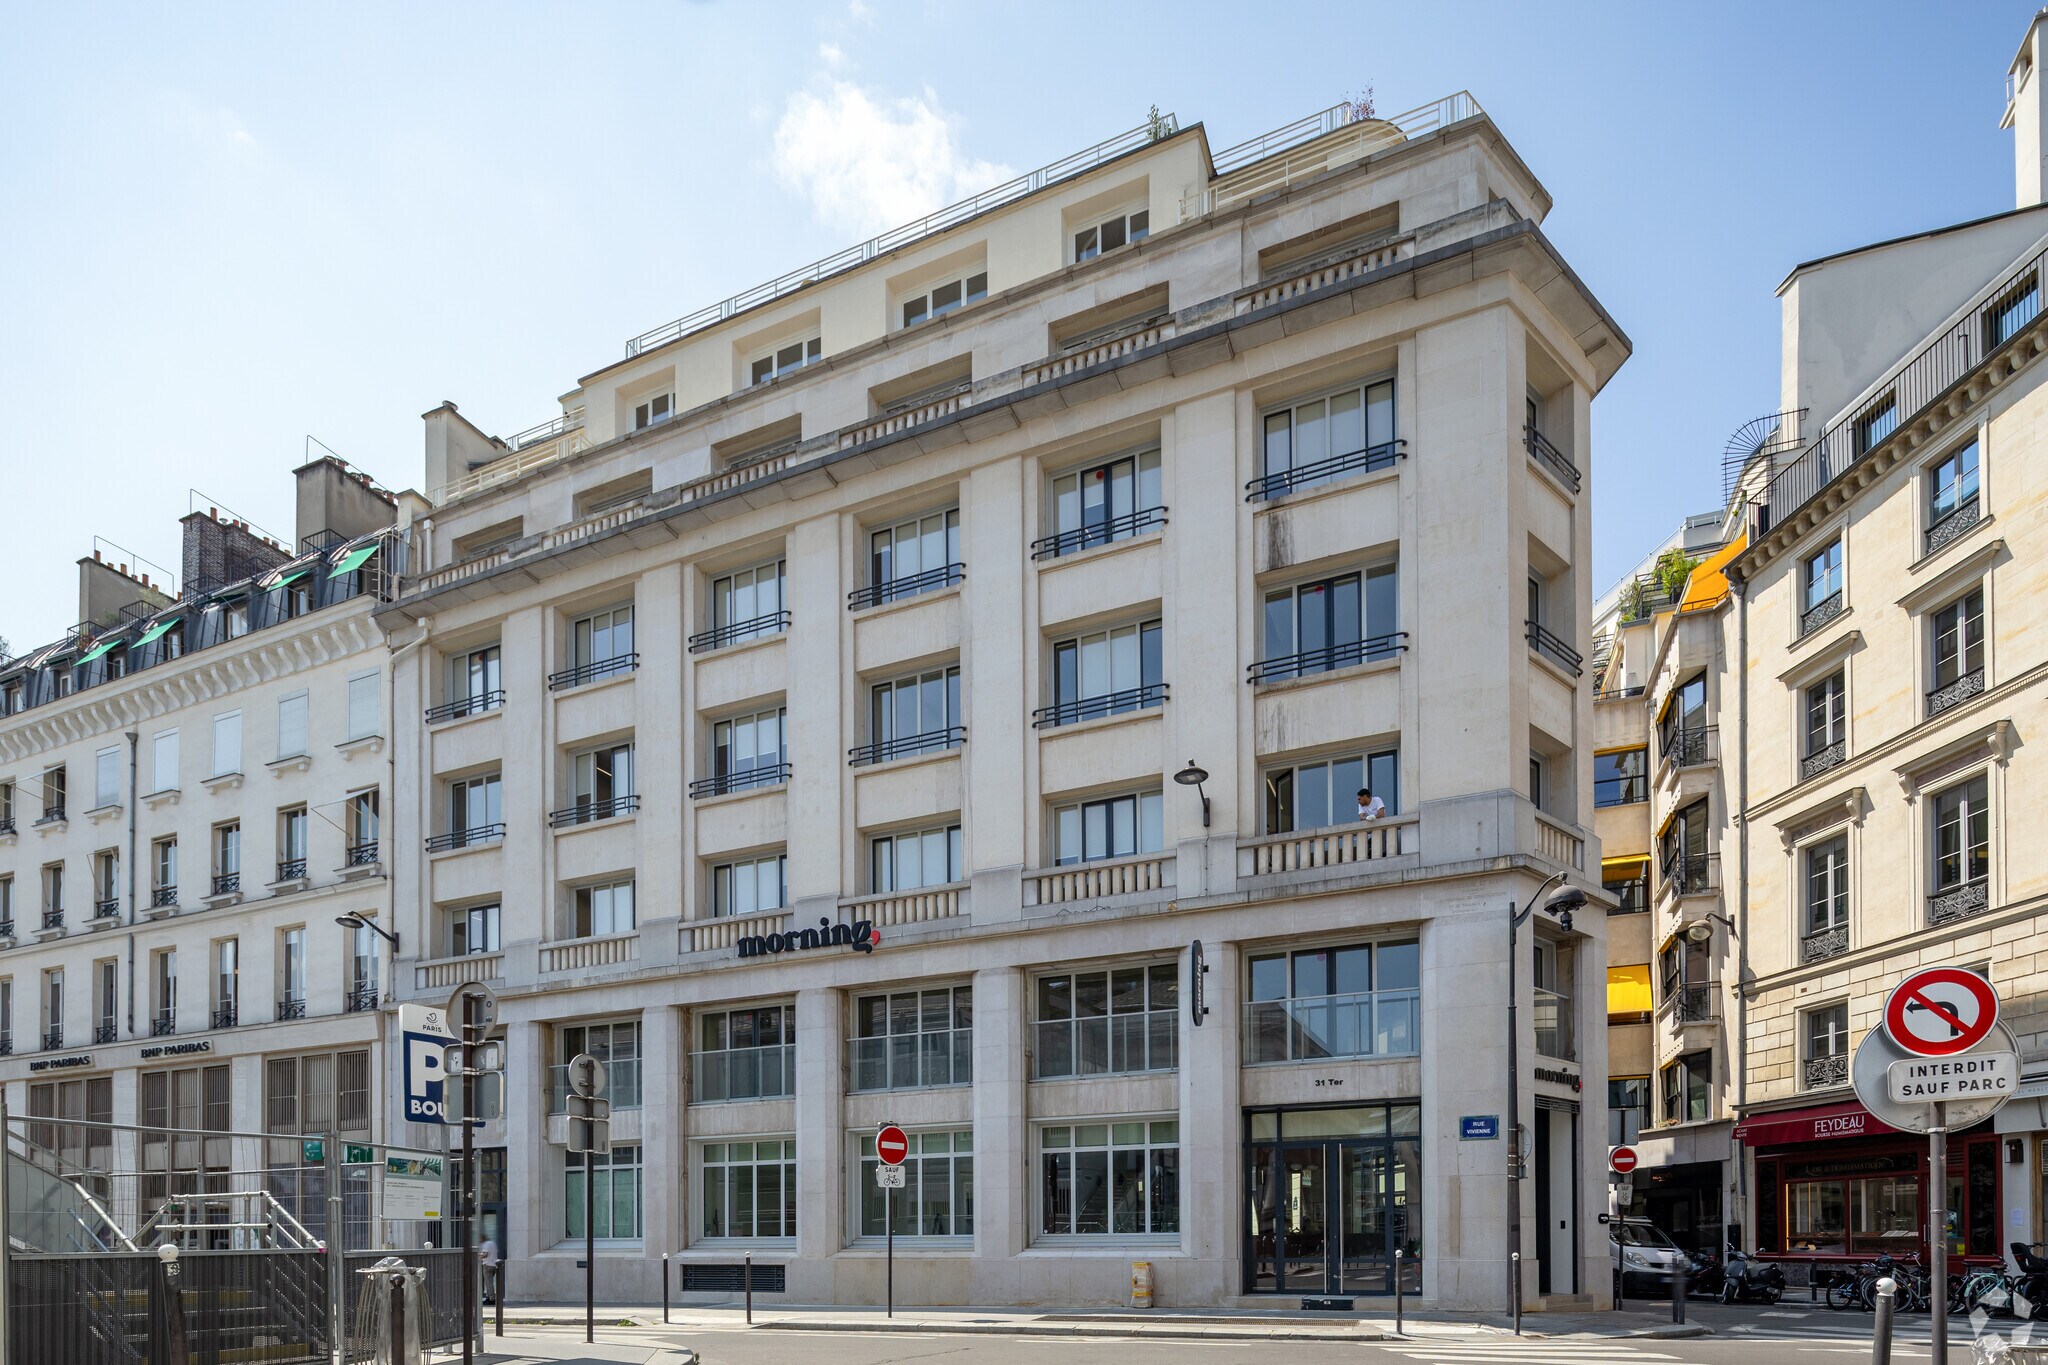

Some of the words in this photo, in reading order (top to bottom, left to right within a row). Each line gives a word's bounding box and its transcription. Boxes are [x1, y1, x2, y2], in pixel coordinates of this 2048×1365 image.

[422, 1024, 442, 1033] PARIS
[141, 1047, 163, 1059] BNP
[164, 1041, 210, 1056] PARIBAS
[30, 1061, 50, 1071] BNP
[50, 1055, 91, 1069] PARIBAS
[409, 1039, 445, 1097] P
[1909, 1059, 1997, 1078] INTERDIT
[1315, 1079, 1325, 1087] 31
[1328, 1078, 1344, 1086] Ter
[1902, 1081, 1950, 1096] SAUF
[1958, 1077, 2006, 1092] PARC
[1814, 1115, 1865, 1133] FEYDEAU
